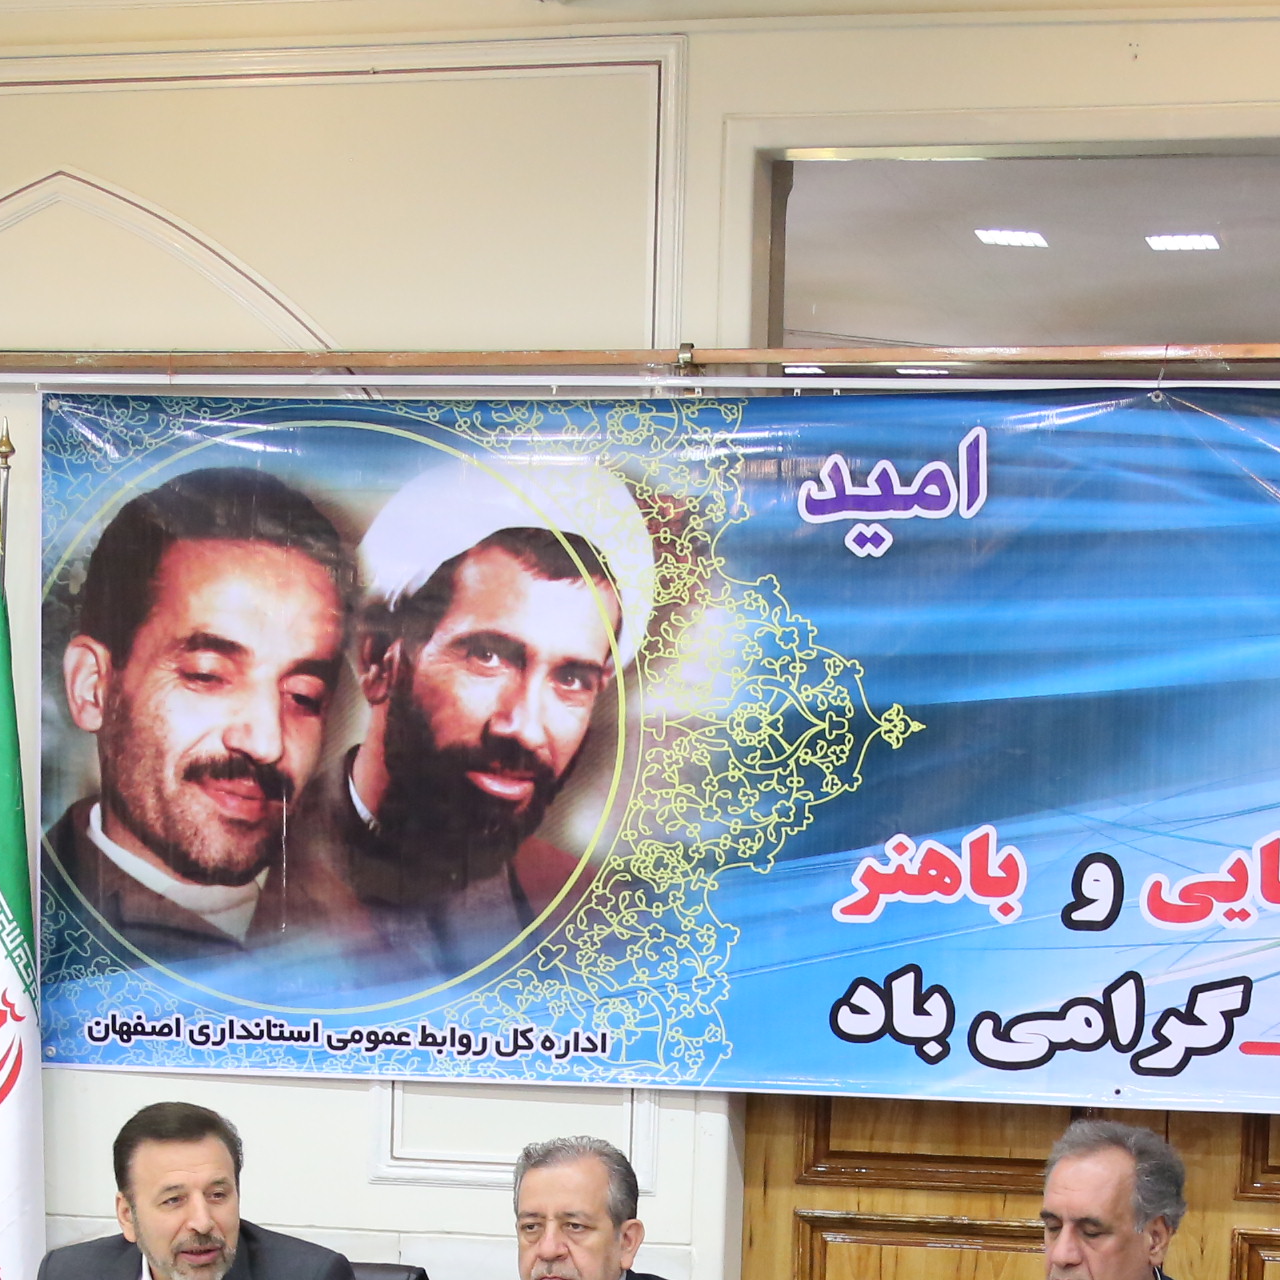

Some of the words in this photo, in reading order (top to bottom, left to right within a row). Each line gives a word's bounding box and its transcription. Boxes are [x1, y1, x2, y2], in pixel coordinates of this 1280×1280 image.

[797, 426, 989, 557] امید
[831, 824, 1028, 926] باهنر
[1062, 851, 1125, 933] و
[86, 1013, 181, 1044] اصفهان
[830, 964, 954, 1066] باد
[968, 970, 1253, 1077] گرامی
[188, 1018, 320, 1046] استانداری
[326, 1027, 412, 1052] عمومی
[417, 1024, 488, 1056] روابط
[494, 1026, 535, 1058] کل
[539, 1030, 608, 1060] اداره
